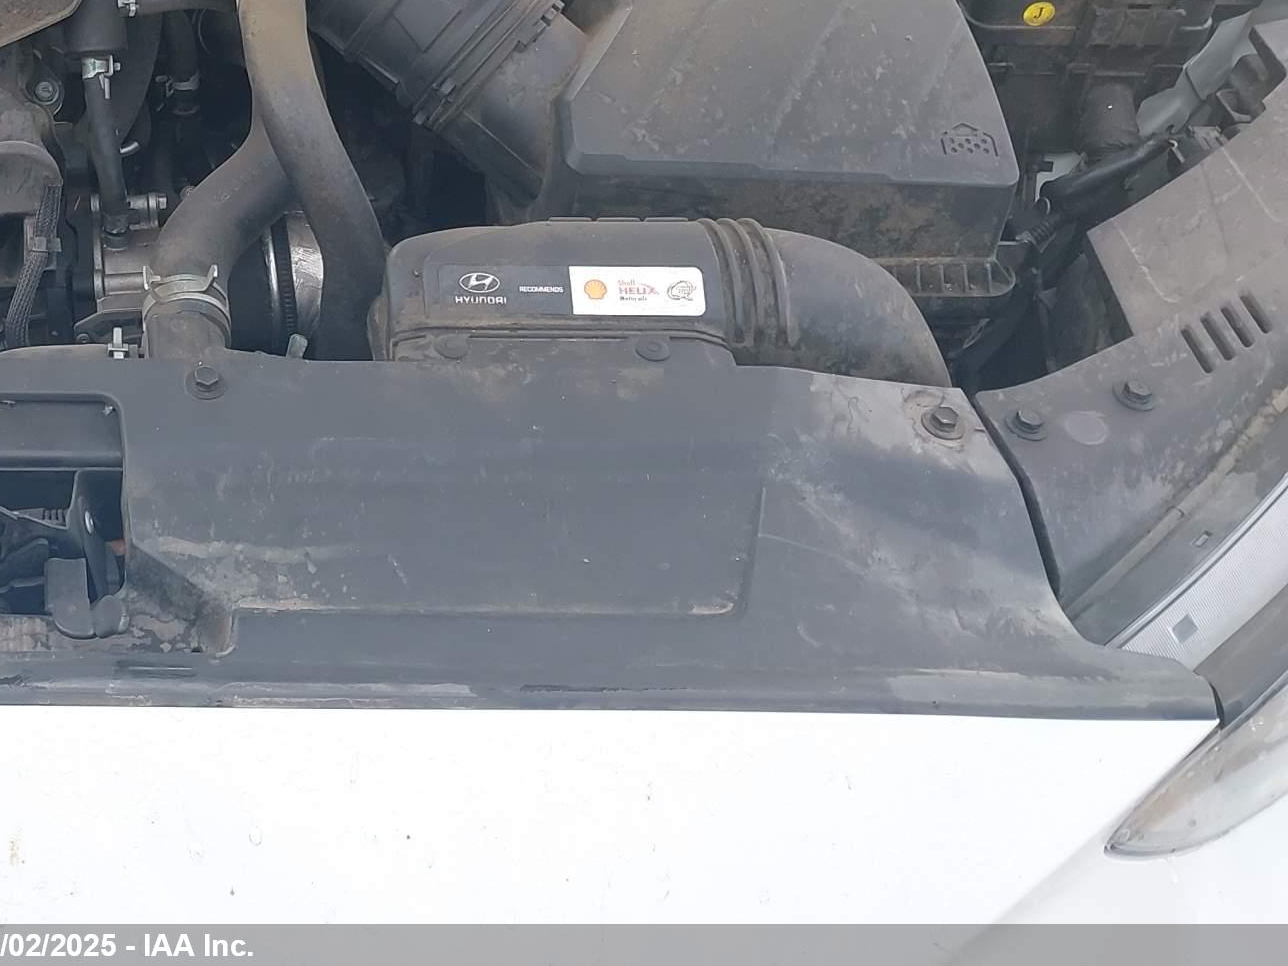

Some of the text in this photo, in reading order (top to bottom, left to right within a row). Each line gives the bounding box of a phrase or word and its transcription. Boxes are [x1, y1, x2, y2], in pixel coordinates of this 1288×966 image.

[519, 285, 564, 293] RECOMMENDS
[618, 286, 656, 295] HELIX
[455, 296, 507, 305] HYUNDAI
